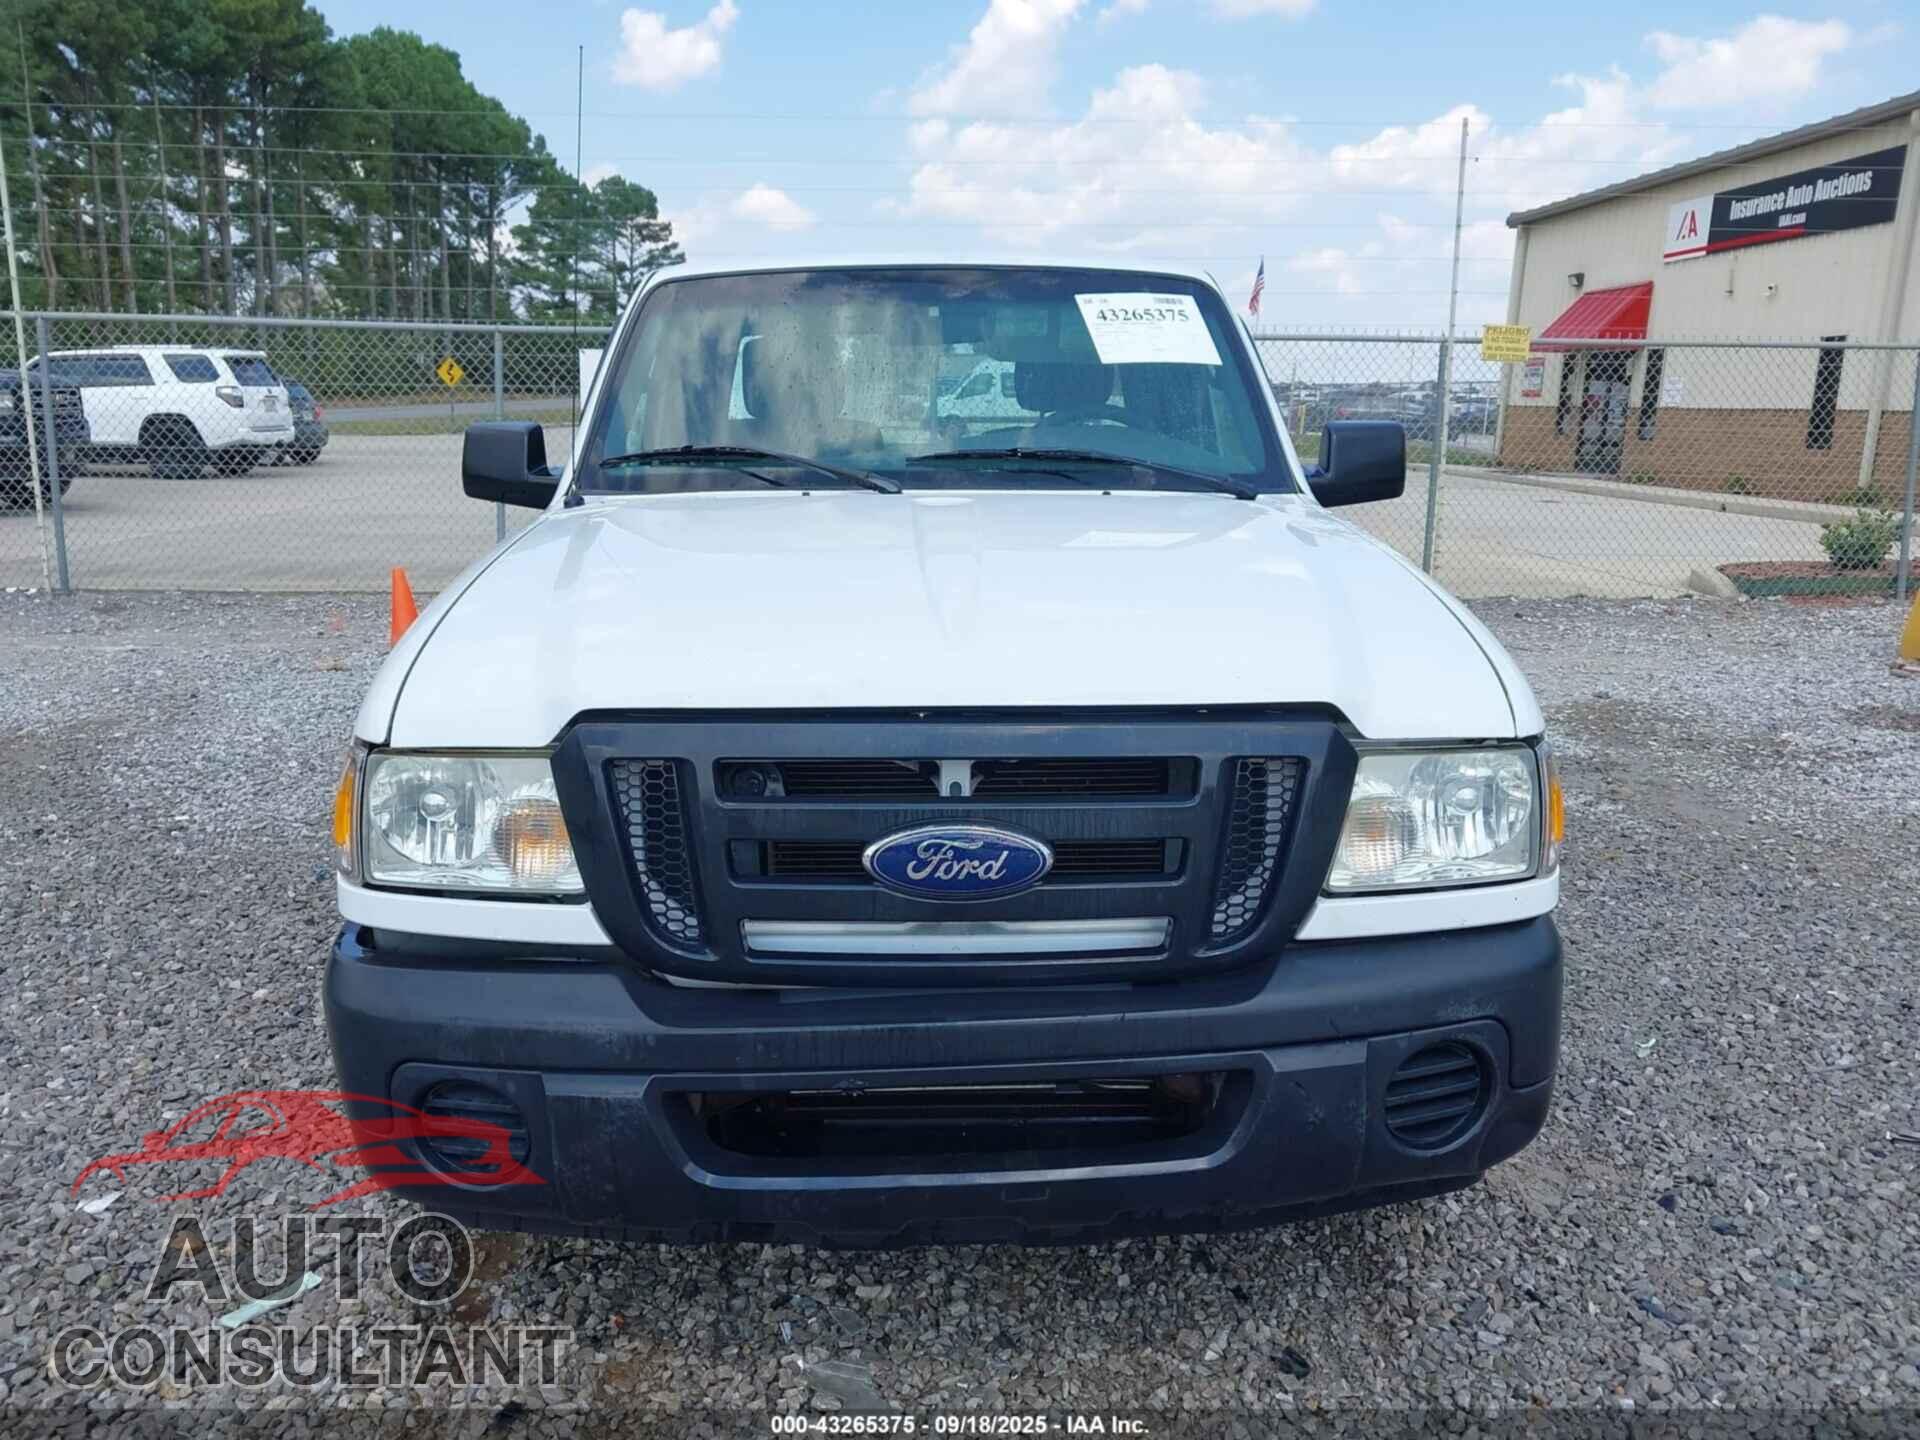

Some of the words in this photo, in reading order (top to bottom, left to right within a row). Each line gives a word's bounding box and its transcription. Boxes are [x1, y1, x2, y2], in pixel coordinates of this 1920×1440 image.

[1730, 192, 1785, 220] Insurance
[1785, 185, 1813, 208] Auto
[1814, 171, 1872, 202] Auctions
[1097, 308, 1189, 321] 43265375
[906, 839, 1009, 881] Ford
